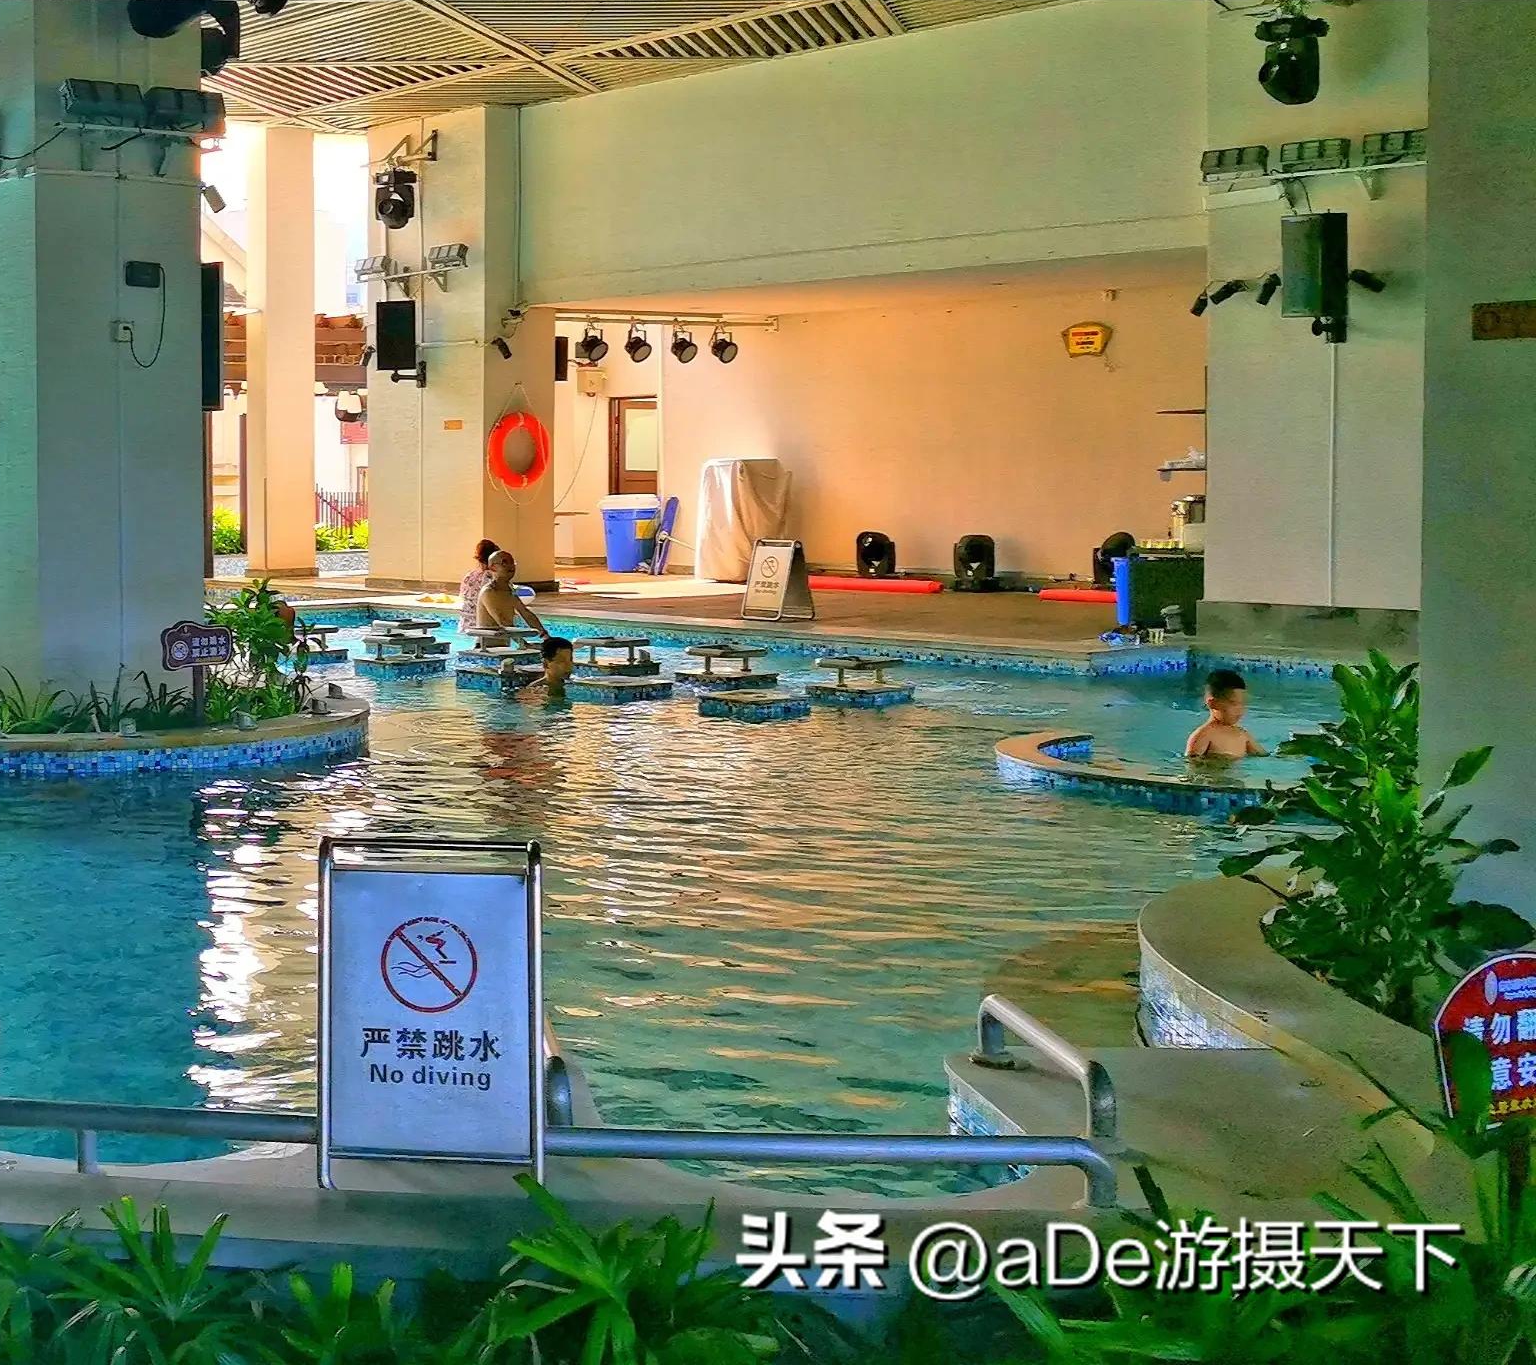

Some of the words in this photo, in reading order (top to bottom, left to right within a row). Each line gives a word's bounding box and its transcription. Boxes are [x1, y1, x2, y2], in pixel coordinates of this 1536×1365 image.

[360, 1027, 502, 1062] 严禁跳水
[370, 1063, 404, 1084] No
[412, 1065, 492, 1091] diving
